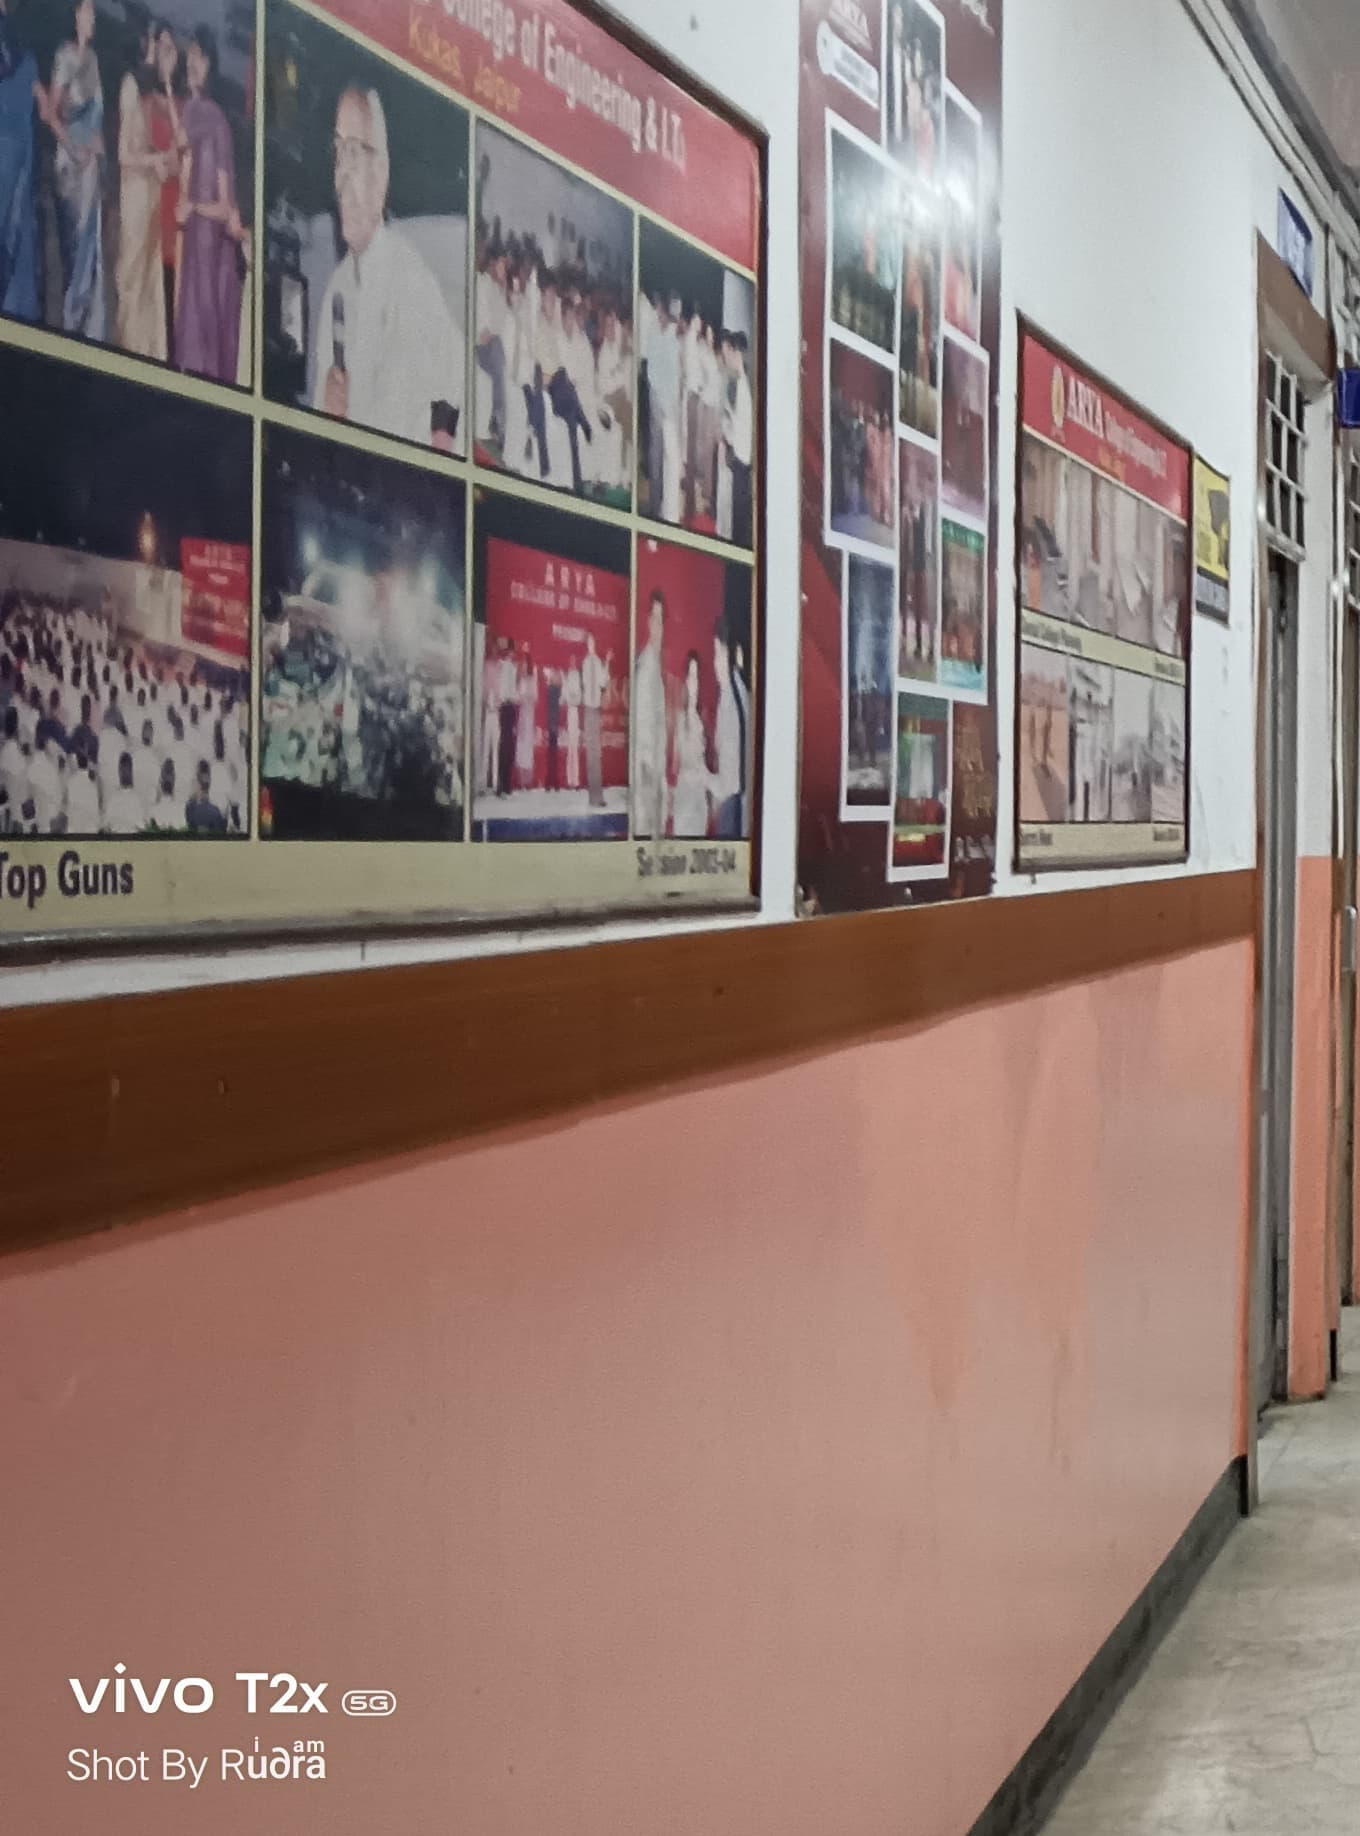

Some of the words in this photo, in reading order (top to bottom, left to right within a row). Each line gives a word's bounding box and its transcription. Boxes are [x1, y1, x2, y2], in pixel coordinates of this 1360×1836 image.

[521, 12, 540, 71] of
[544, 20, 641, 153] Engineering
[645, 96, 658, 153] &
[58, 850, 134, 896] Guns
